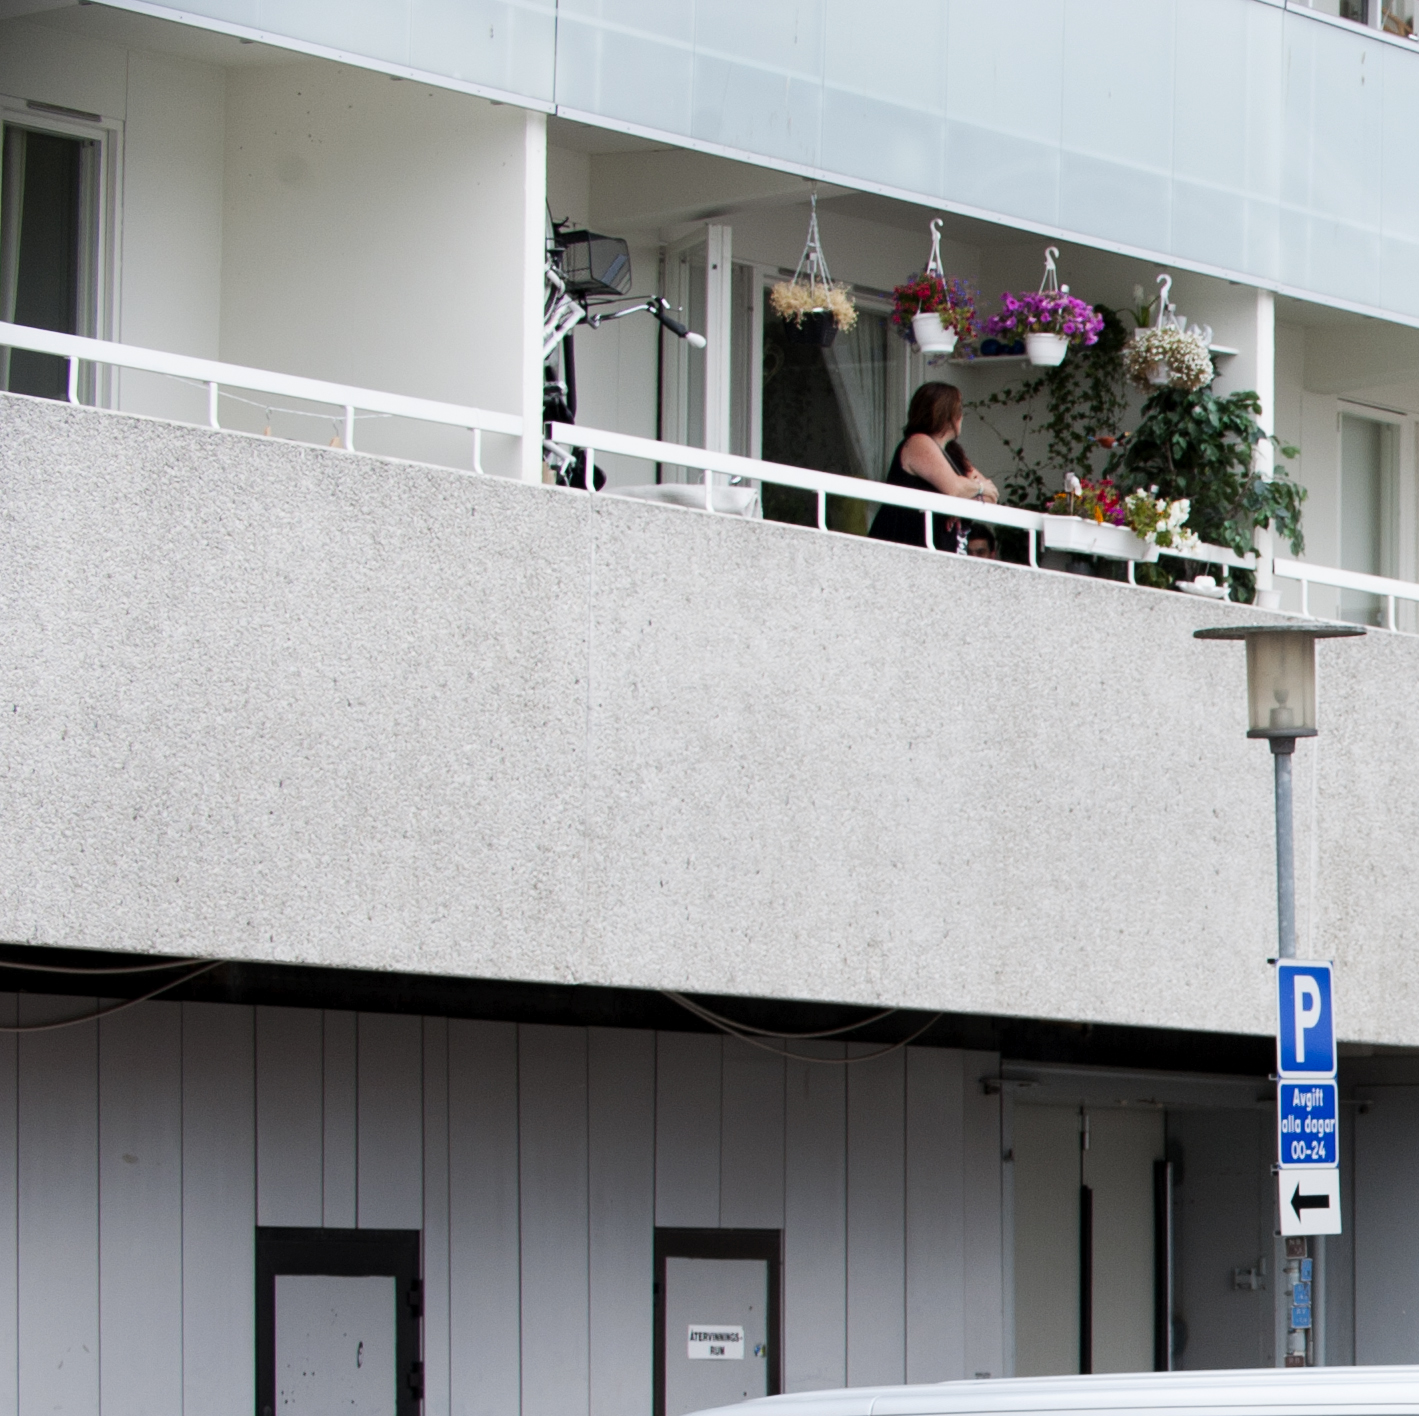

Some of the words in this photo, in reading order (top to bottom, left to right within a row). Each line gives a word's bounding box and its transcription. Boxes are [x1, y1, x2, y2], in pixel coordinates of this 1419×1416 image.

[1294, 975, 1322, 1063] P
[1293, 1088, 1324, 1111] Avgift
[1282, 1114, 1301, 1133] alla
[1304, 1115, 1336, 1137] dagar
[1291, 1140, 1326, 1160] 00-24
